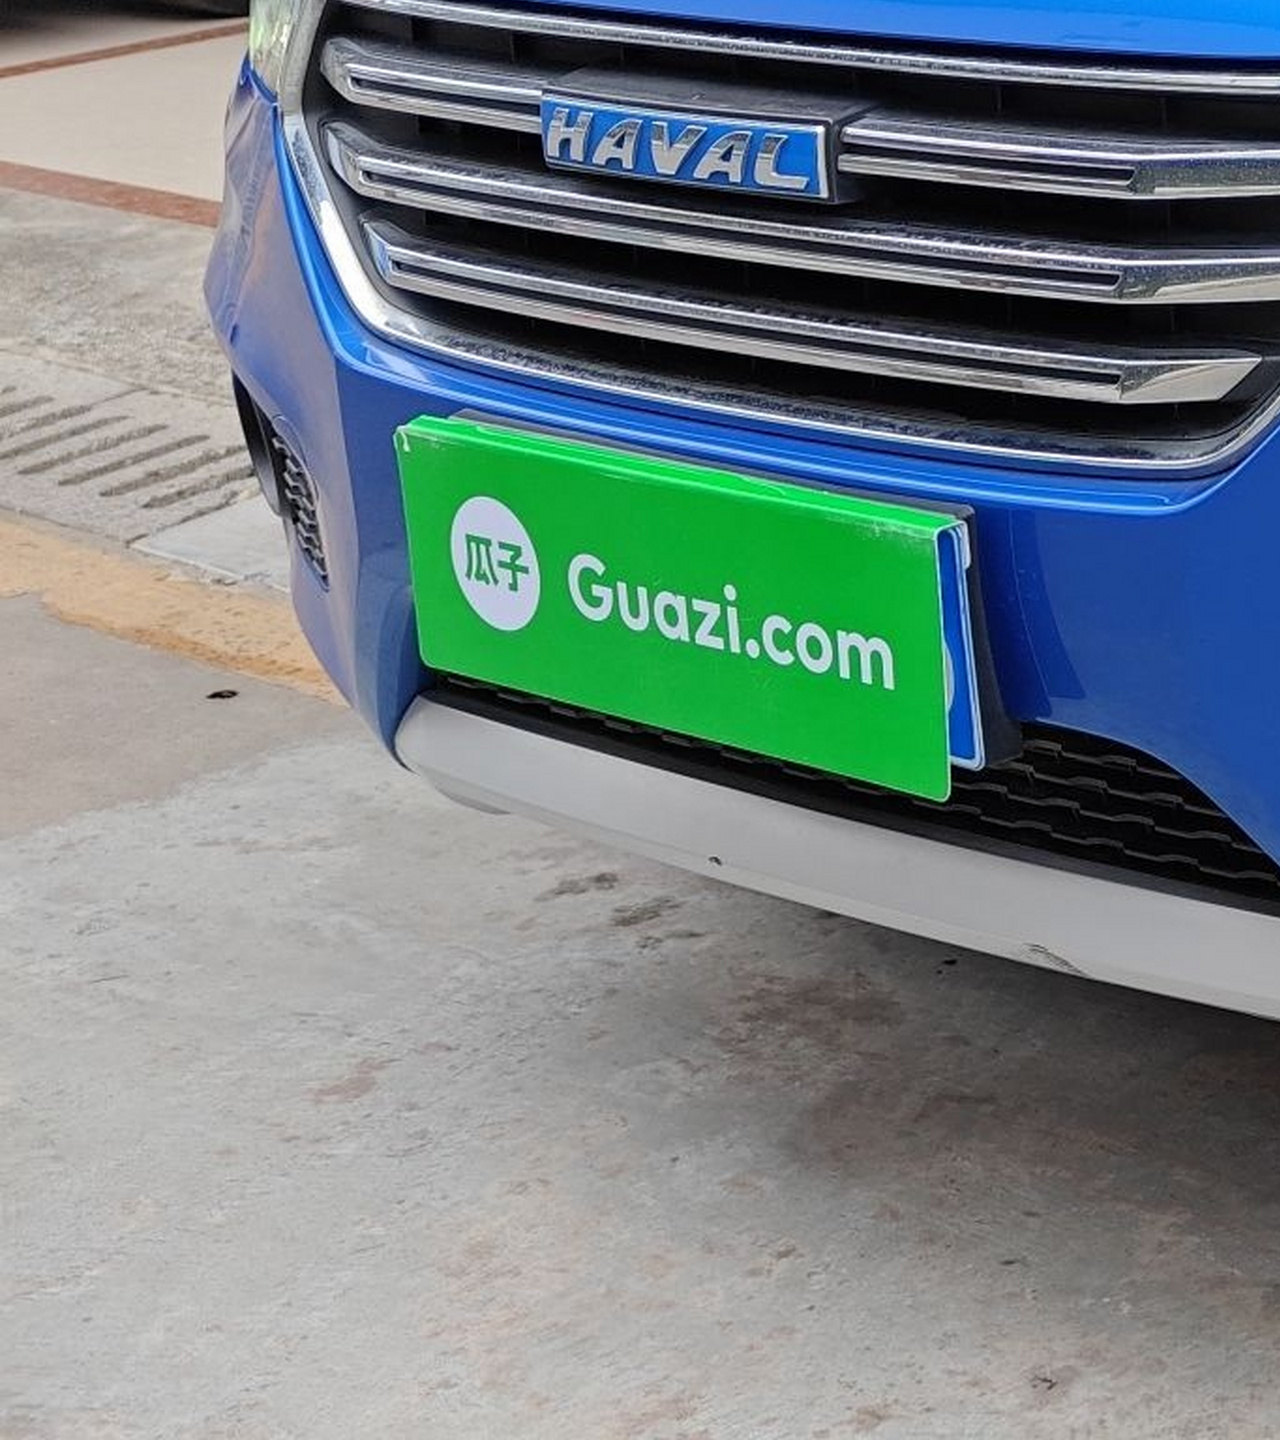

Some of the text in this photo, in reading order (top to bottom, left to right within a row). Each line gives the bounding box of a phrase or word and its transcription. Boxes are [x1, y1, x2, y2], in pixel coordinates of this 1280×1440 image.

[547, 108, 810, 190] HAVAL
[464, 532, 530, 593] 瓜子
[567, 552, 896, 691] Guazi.com
